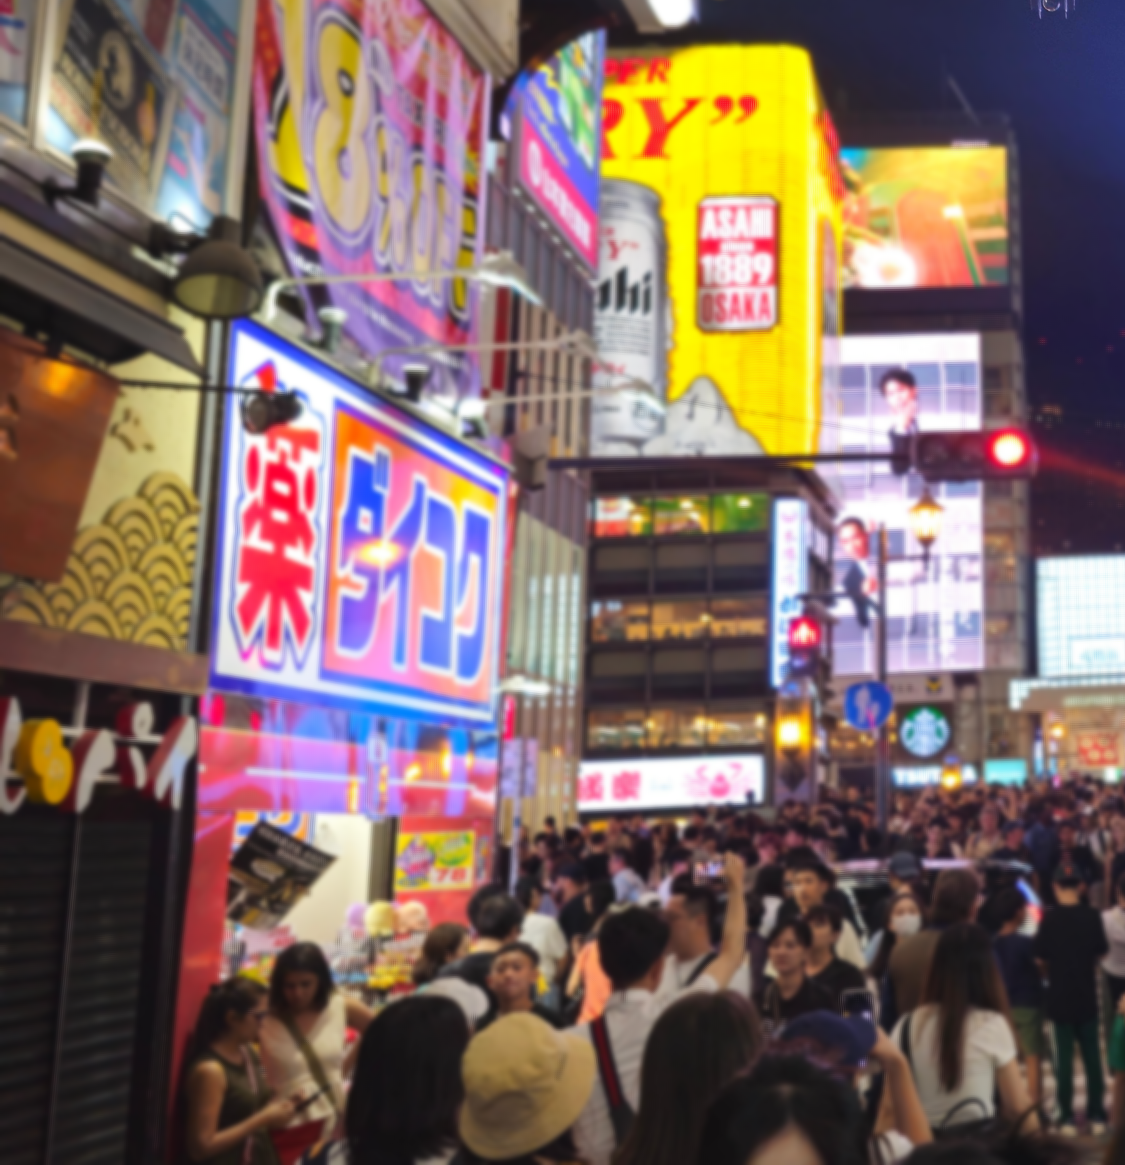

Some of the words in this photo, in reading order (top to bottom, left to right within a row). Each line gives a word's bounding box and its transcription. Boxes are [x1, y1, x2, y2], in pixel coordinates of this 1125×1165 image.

[700, 208, 773, 239] ASAHI
[702, 253, 773, 285] 1889
[701, 291, 772, 323] OSAKA
[335, 444, 494, 685] ダイコク
[892, 765, 977, 787] TSUTA
